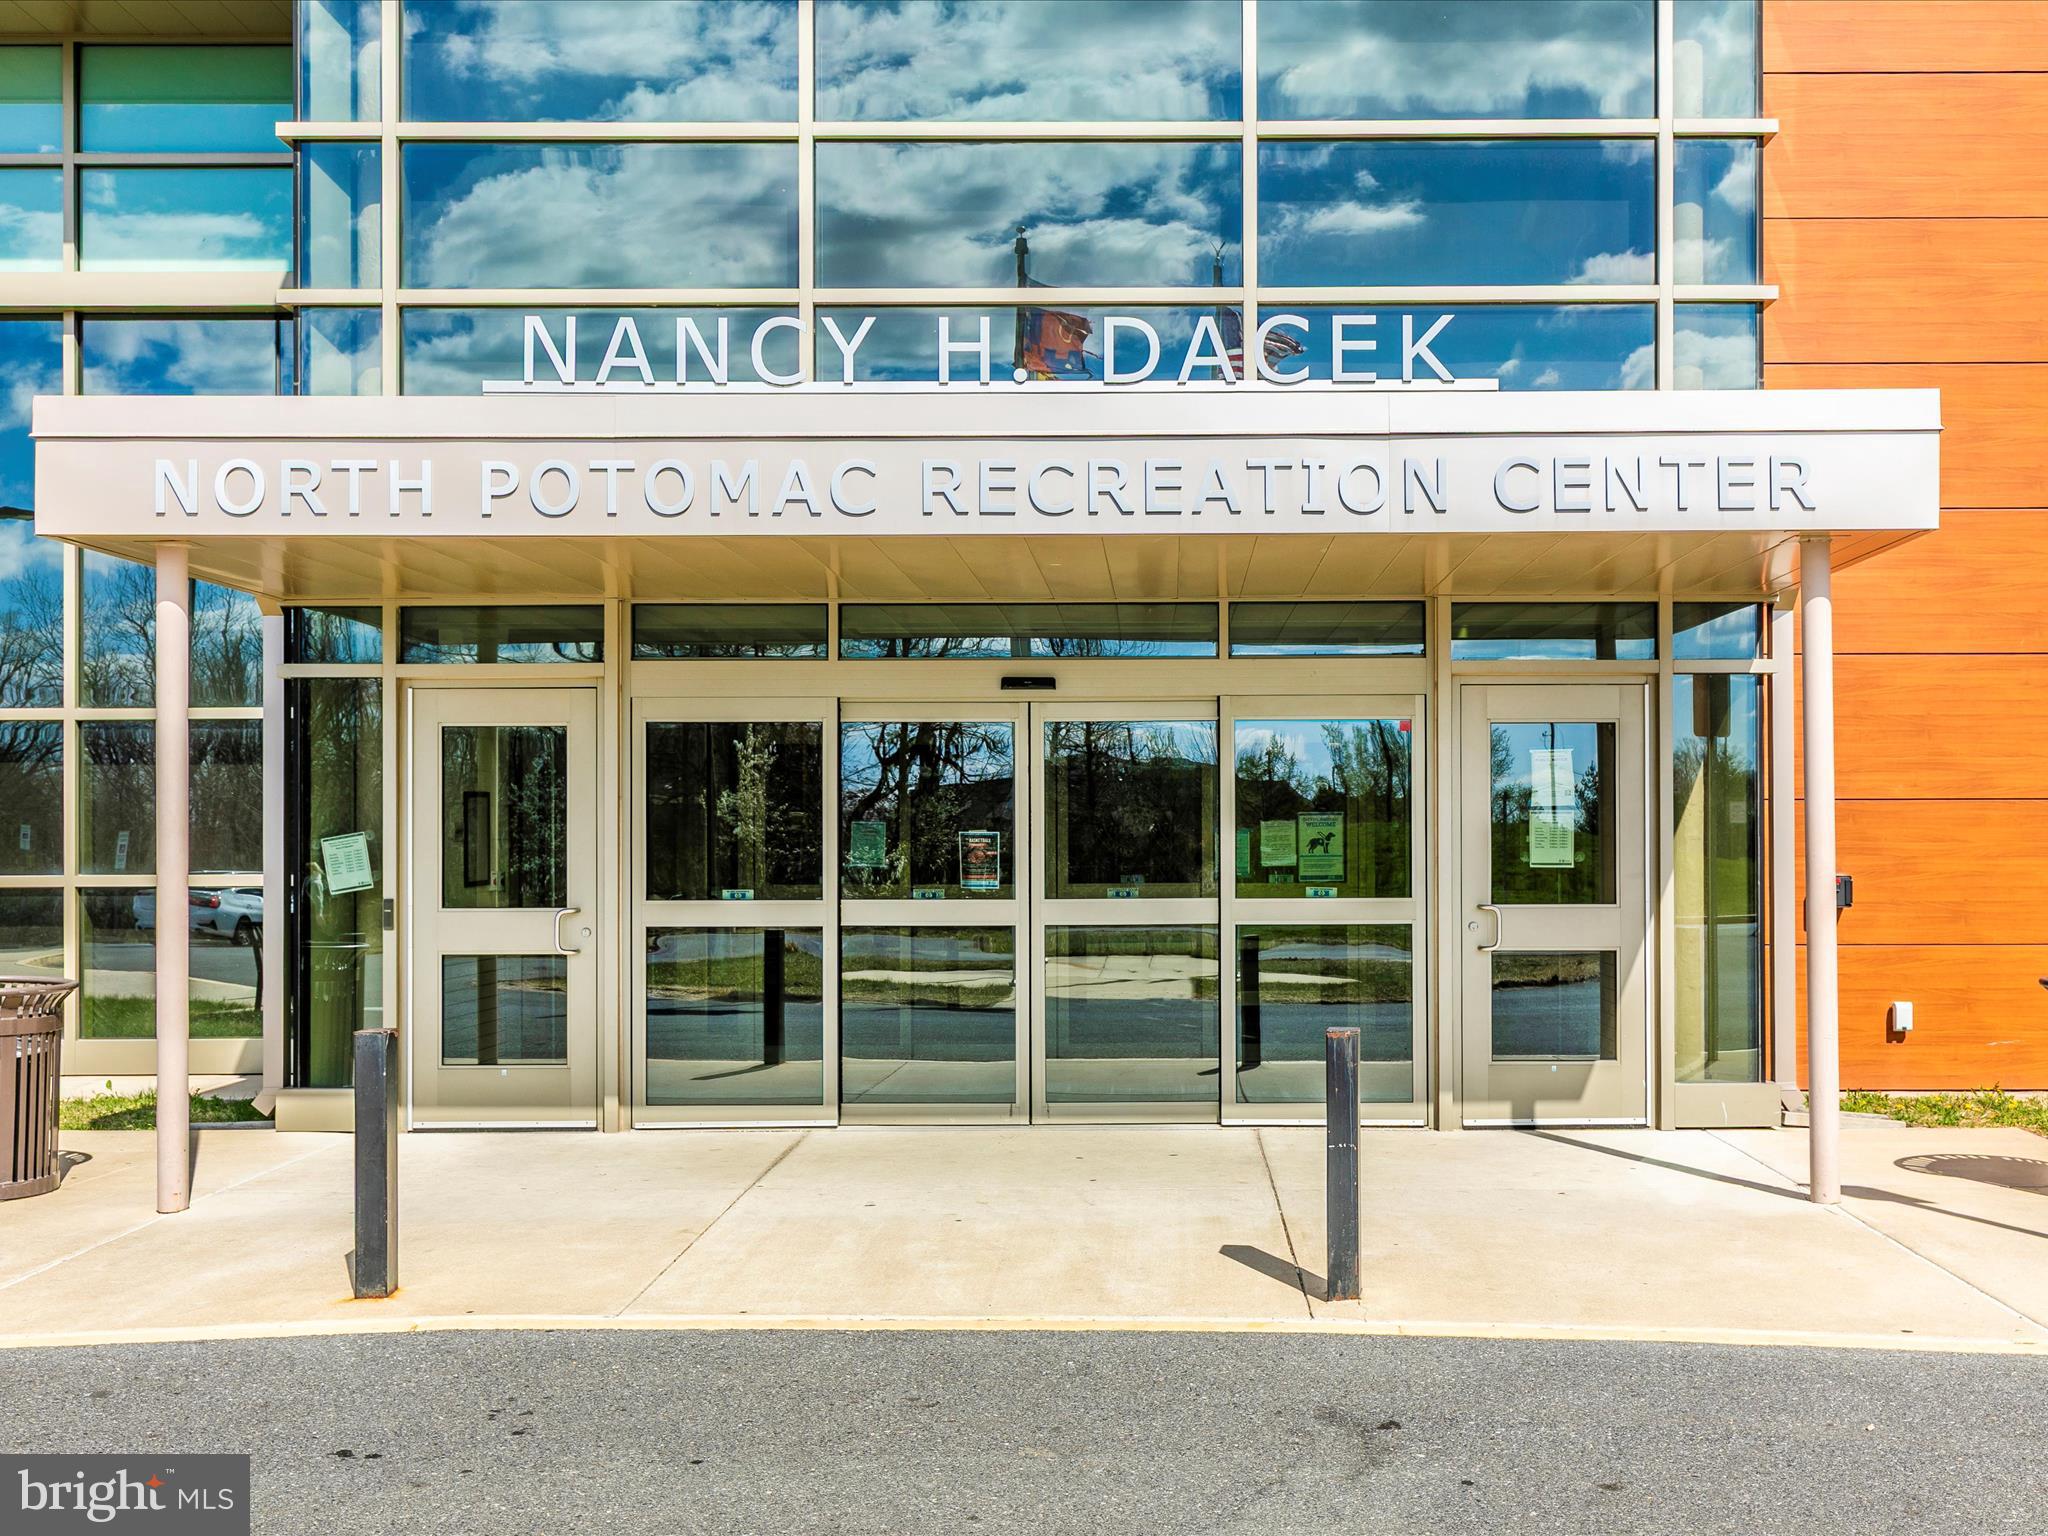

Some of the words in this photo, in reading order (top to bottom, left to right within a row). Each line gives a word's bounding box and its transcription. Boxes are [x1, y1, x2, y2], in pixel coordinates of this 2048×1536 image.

[524, 315, 877, 387] NANCY
[938, 316, 1028, 384] H.
[1103, 314, 1456, 385] DACEK
[155, 458, 433, 517] NORTH
[480, 458, 878, 518] POTOMAC
[921, 456, 1448, 516] RECREATION
[1493, 454, 1817, 513] CENTER
